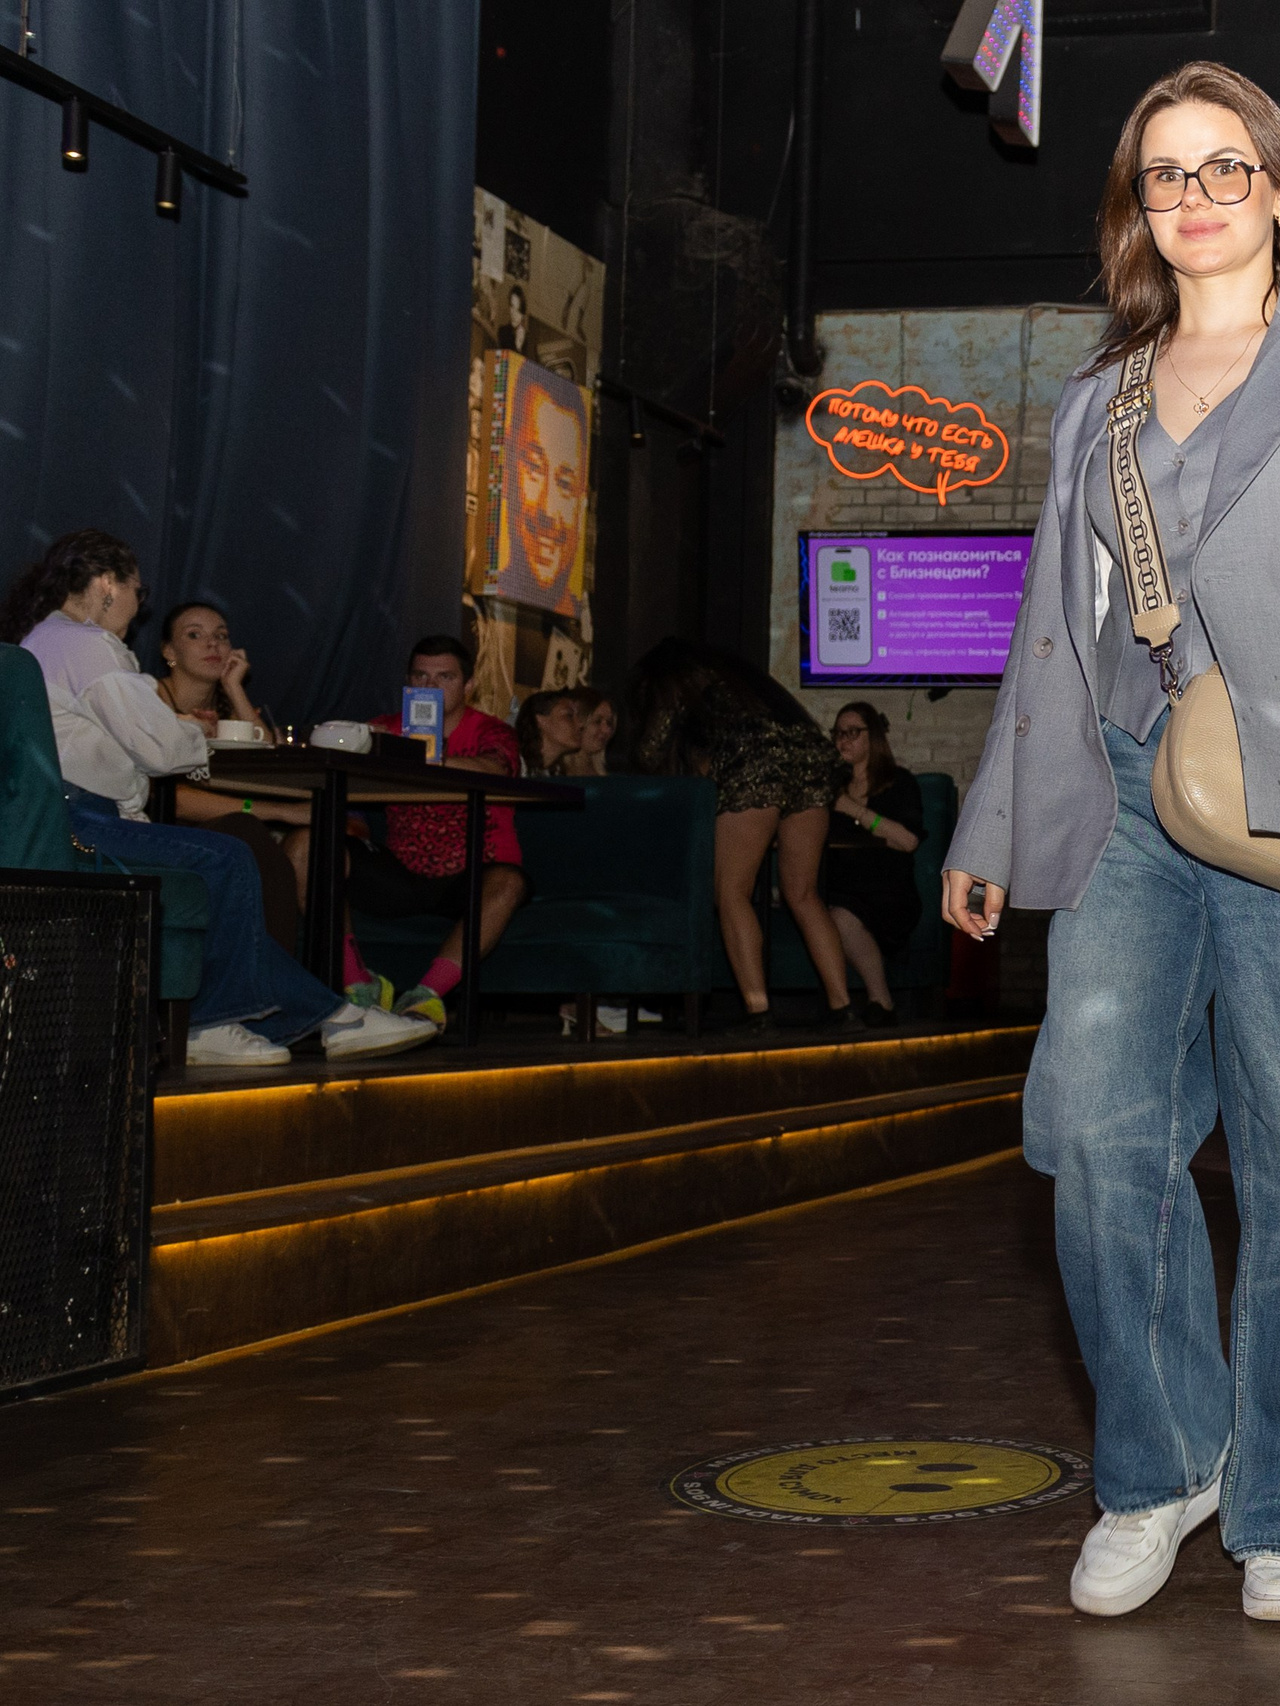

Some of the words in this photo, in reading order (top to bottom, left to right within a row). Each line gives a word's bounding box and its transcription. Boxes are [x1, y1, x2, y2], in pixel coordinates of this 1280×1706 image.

[828, 398, 899, 428] ПОТОМУ
[902, 414, 939, 438] ЧТО
[941, 423, 994, 449] ЕСТЬ
[910, 441, 924, 460] У
[927, 446, 981, 473] ТЕБЯ
[877, 548, 905, 563] Как
[908, 550, 1022, 563] познакомиться
[877, 568, 887, 580] с
[890, 564, 990, 581] Близнецами?
[707, 1448, 777, 1467] MADE
[817, 1449, 918, 1466] МЕСТО
[1021, 1481, 1086, 1506] MADE
[703, 1499, 734, 1510] IN
[984, 1504, 1021, 1514] IN
[729, 1507, 824, 1523] MADE
